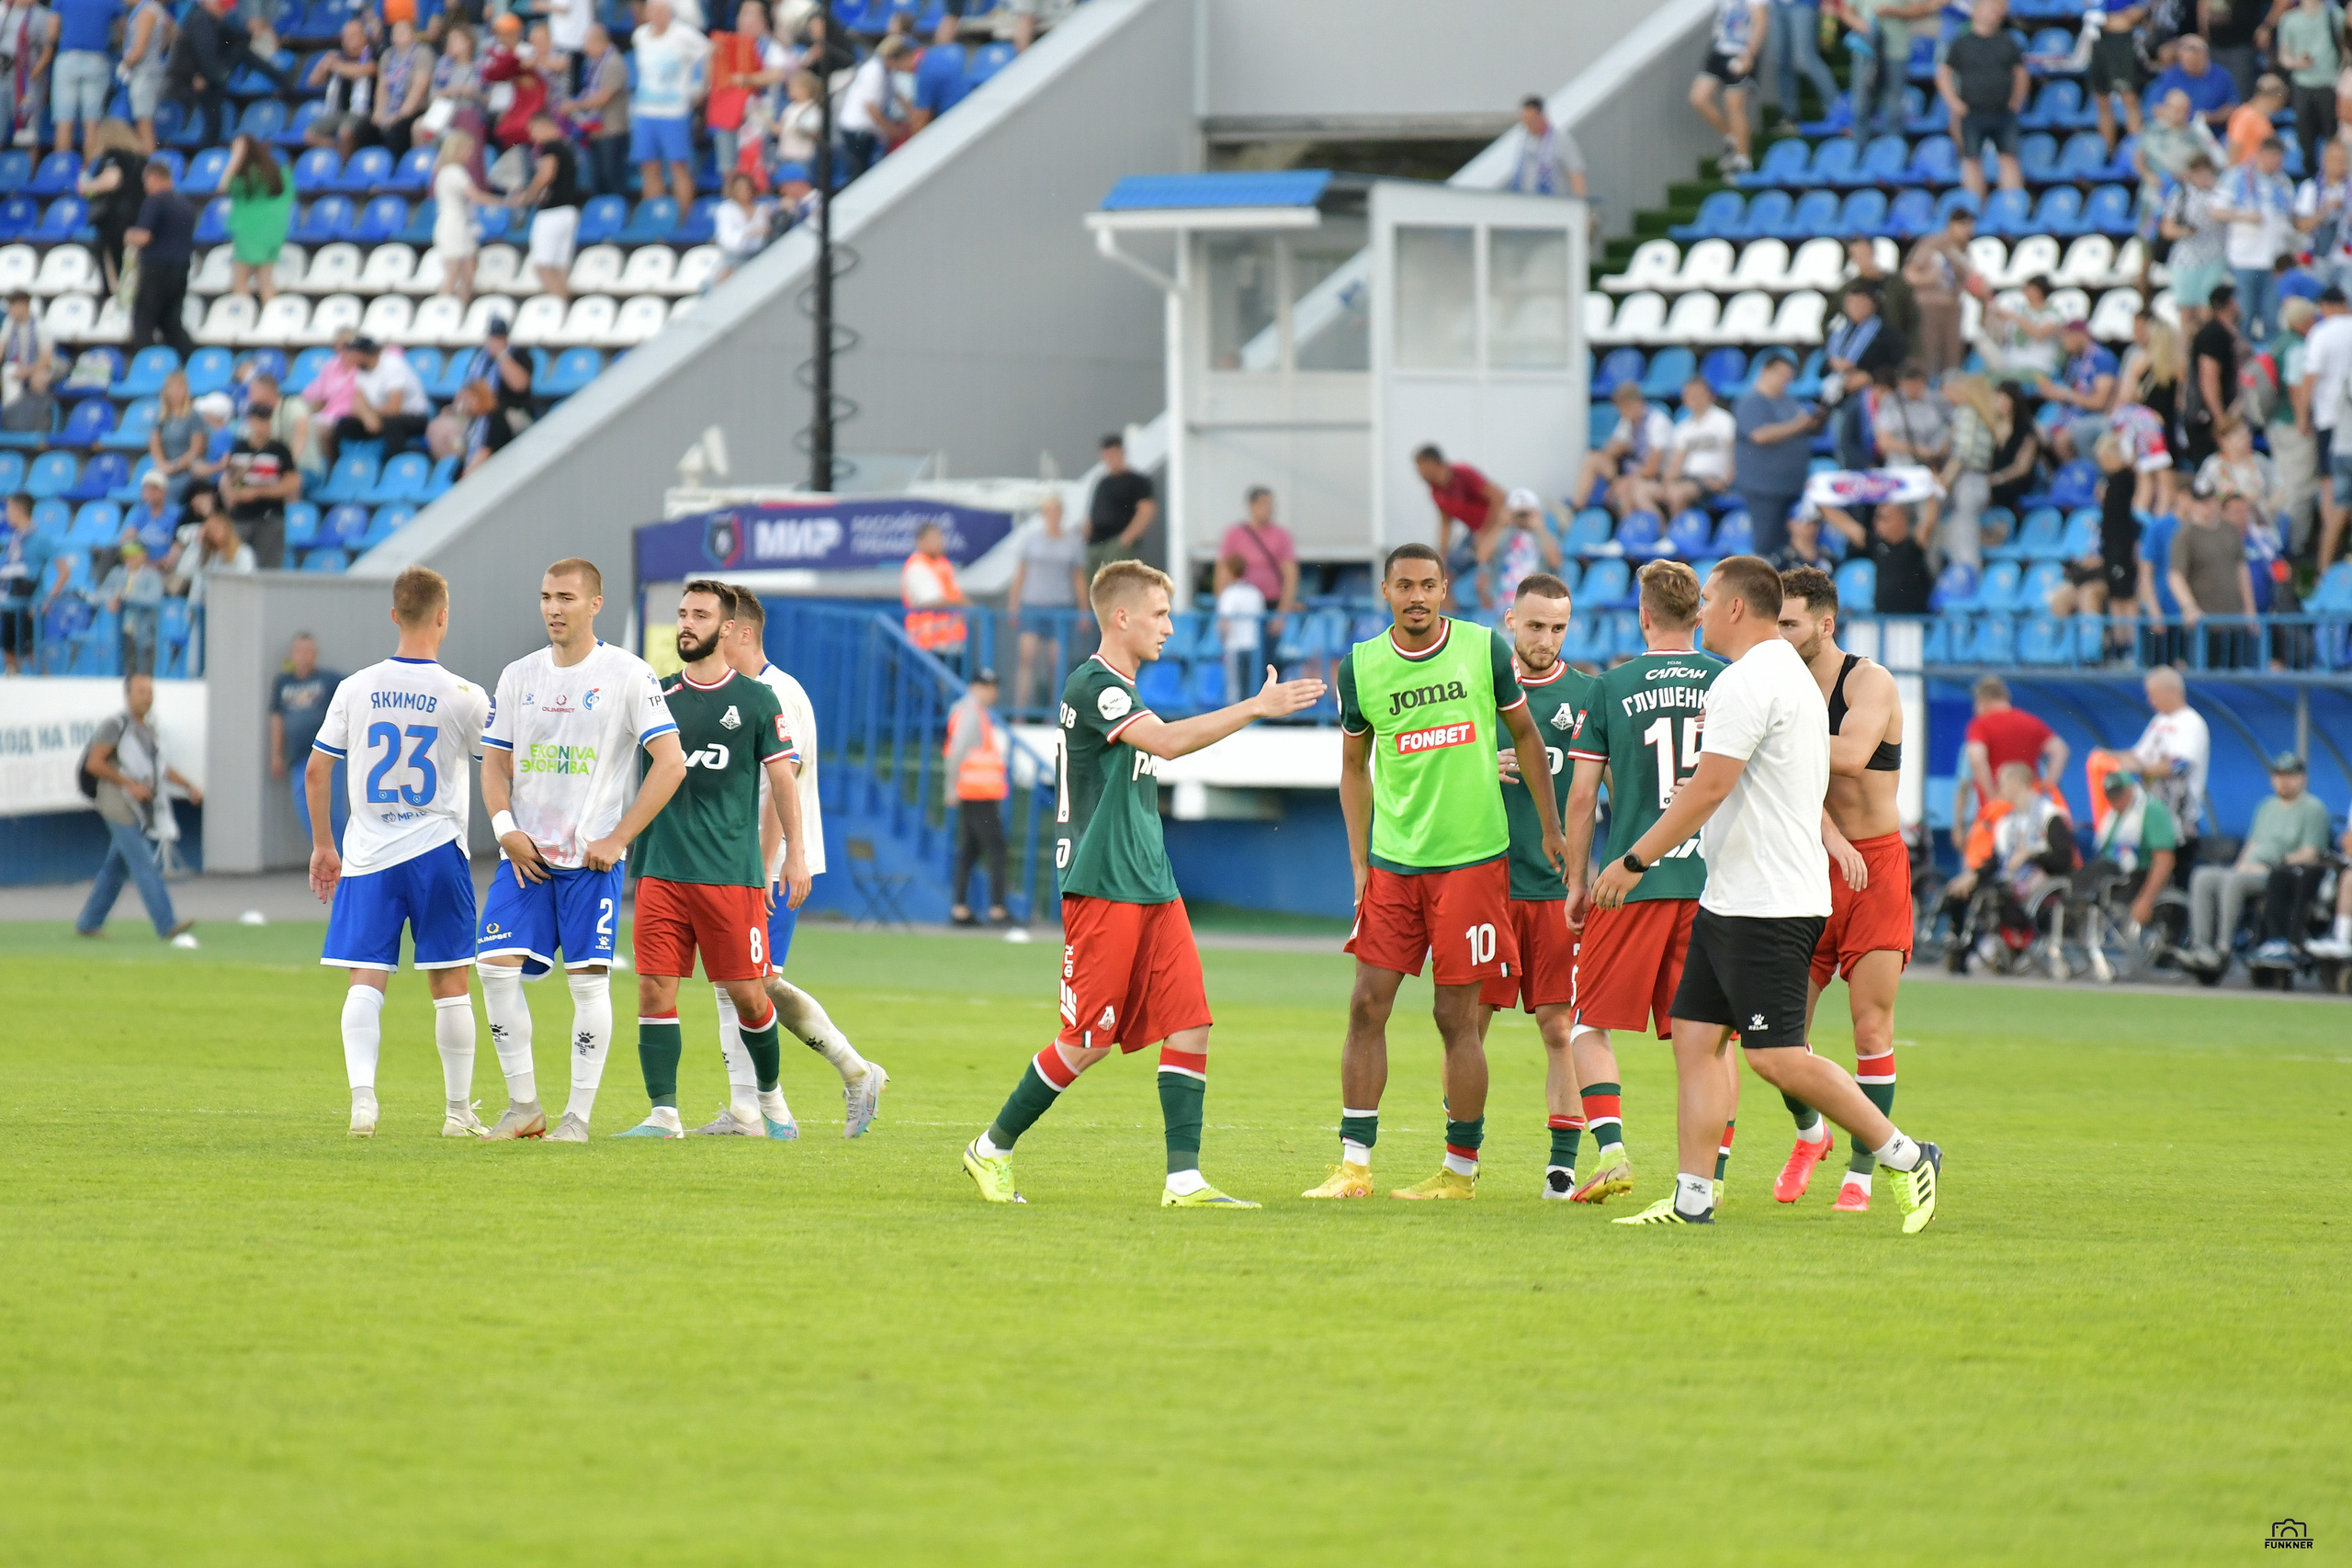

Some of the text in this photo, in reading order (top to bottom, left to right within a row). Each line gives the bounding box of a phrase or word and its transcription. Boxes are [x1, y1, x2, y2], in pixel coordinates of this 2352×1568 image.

[754, 517, 842, 558] МИР
[370, 691, 437, 713] ЯКИМОВ
[39, 723, 64, 749] НА
[1400, 724, 1470, 751] FONBET
[367, 721, 438, 807] 23
[519, 759, 590, 775] ЭКОНИВА
[530, 744, 597, 761] EKONIVA
[596, 897, 613, 935] 2
[750, 926, 763, 964] 8
[1465, 923, 1496, 966] 10
